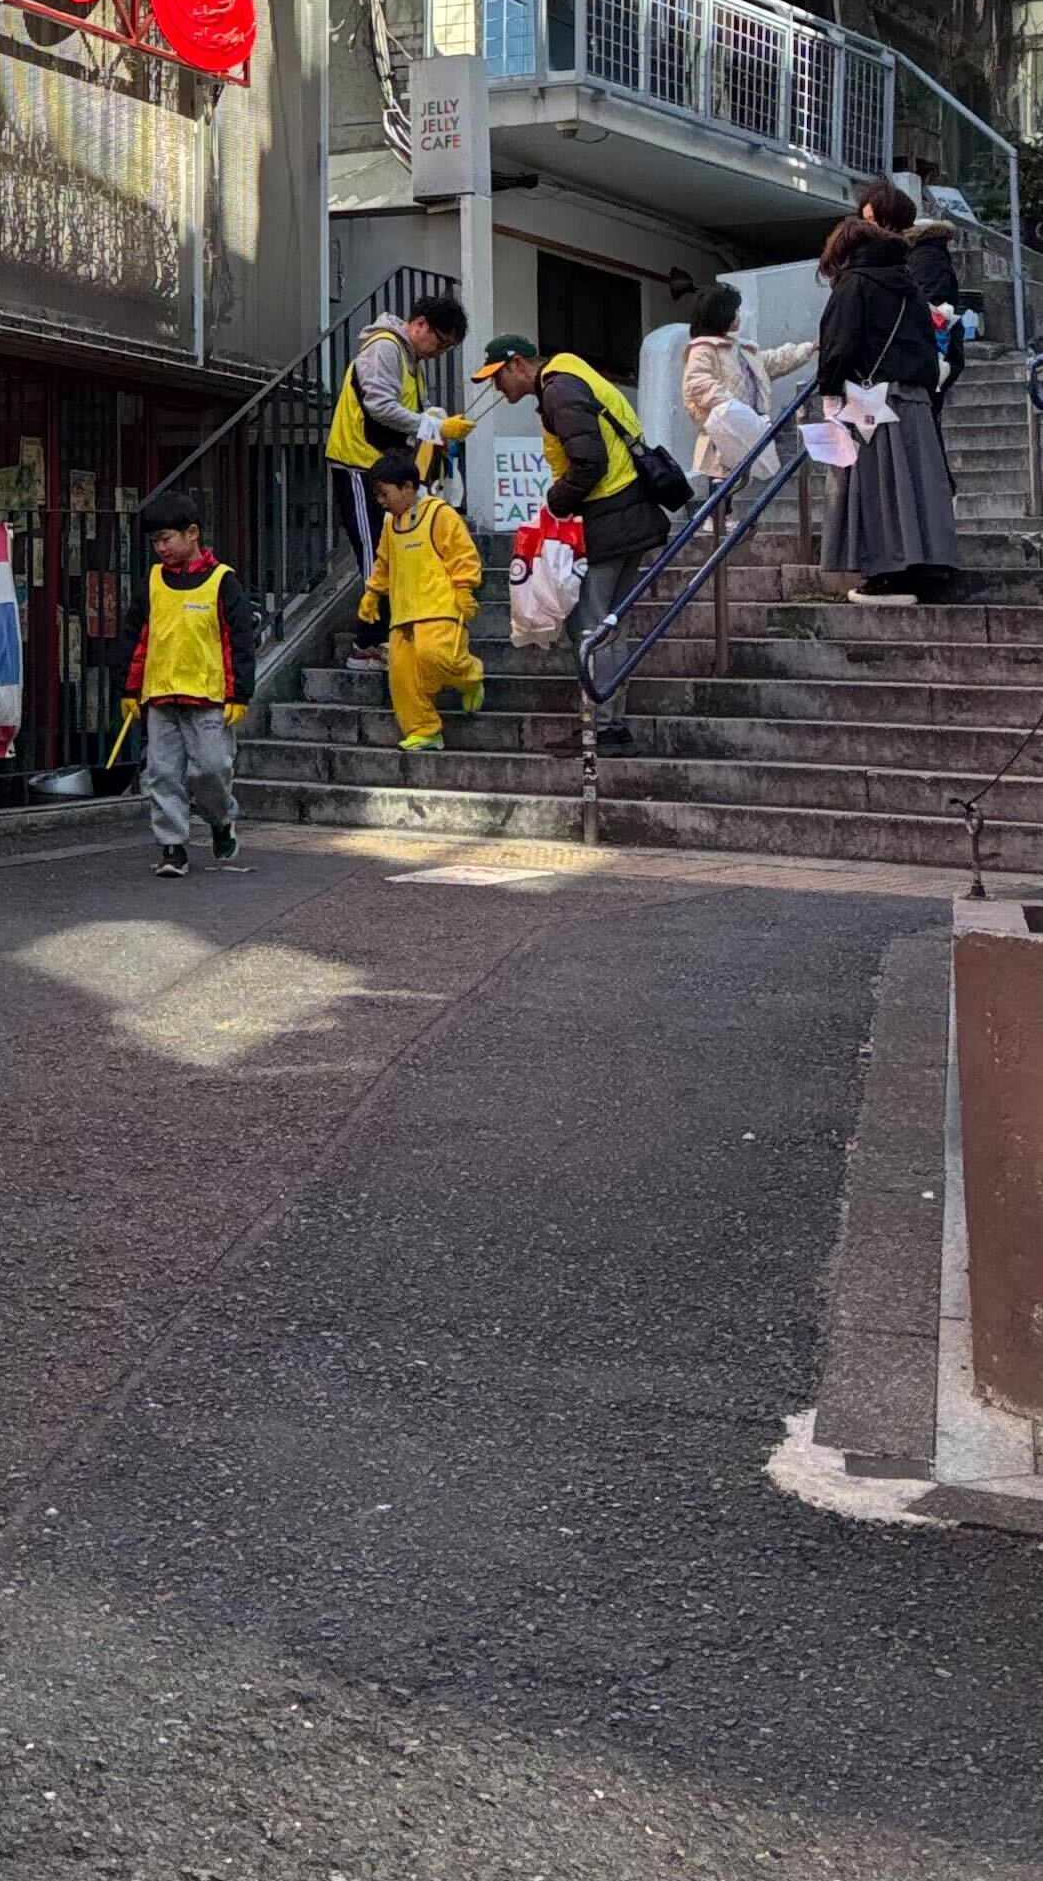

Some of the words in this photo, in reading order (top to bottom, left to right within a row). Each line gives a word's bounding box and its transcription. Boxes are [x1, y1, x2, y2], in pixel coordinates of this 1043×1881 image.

[420, 98, 460, 117] JELLY
[421, 116, 460, 135] JELLY
[420, 133, 462, 151] CAFE
[495, 453, 545, 473] ELLY
[498, 477, 548, 497] ELLY
[493, 502, 538, 522] CAF
